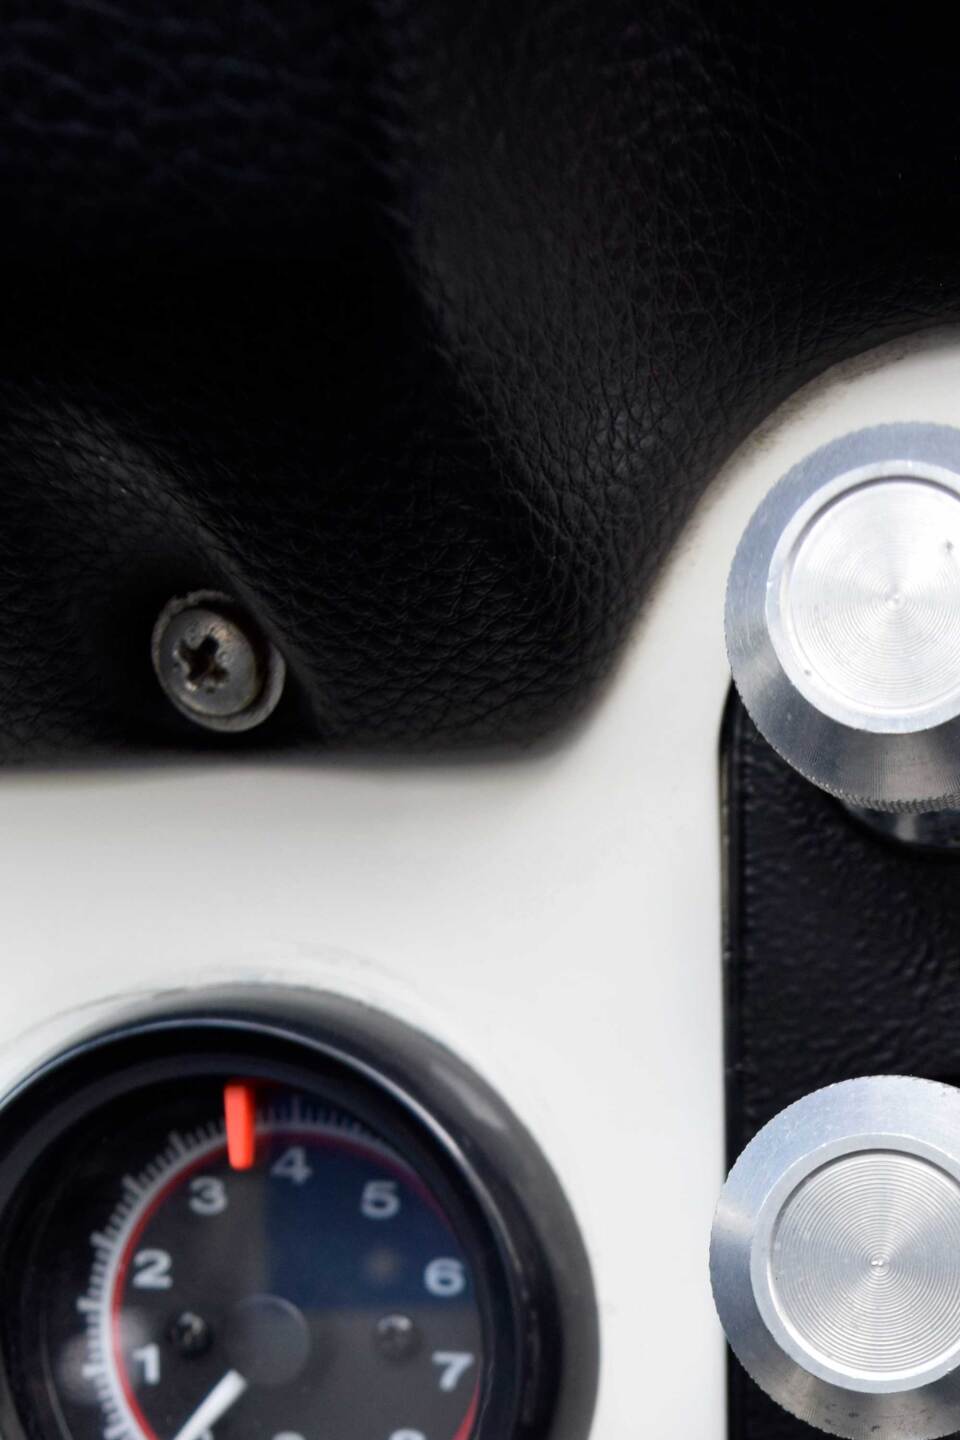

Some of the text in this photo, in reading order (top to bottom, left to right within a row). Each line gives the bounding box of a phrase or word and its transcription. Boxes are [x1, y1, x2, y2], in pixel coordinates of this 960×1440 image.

[272, 1146, 312, 1183] 4
[189, 1176, 226, 1213] 3
[361, 1181, 399, 1218] 5
[133, 1250, 172, 1289] 2
[424, 1257, 465, 1295] 6
[133, 1347, 161, 1385] 1
[432, 1351, 473, 1390] 7
